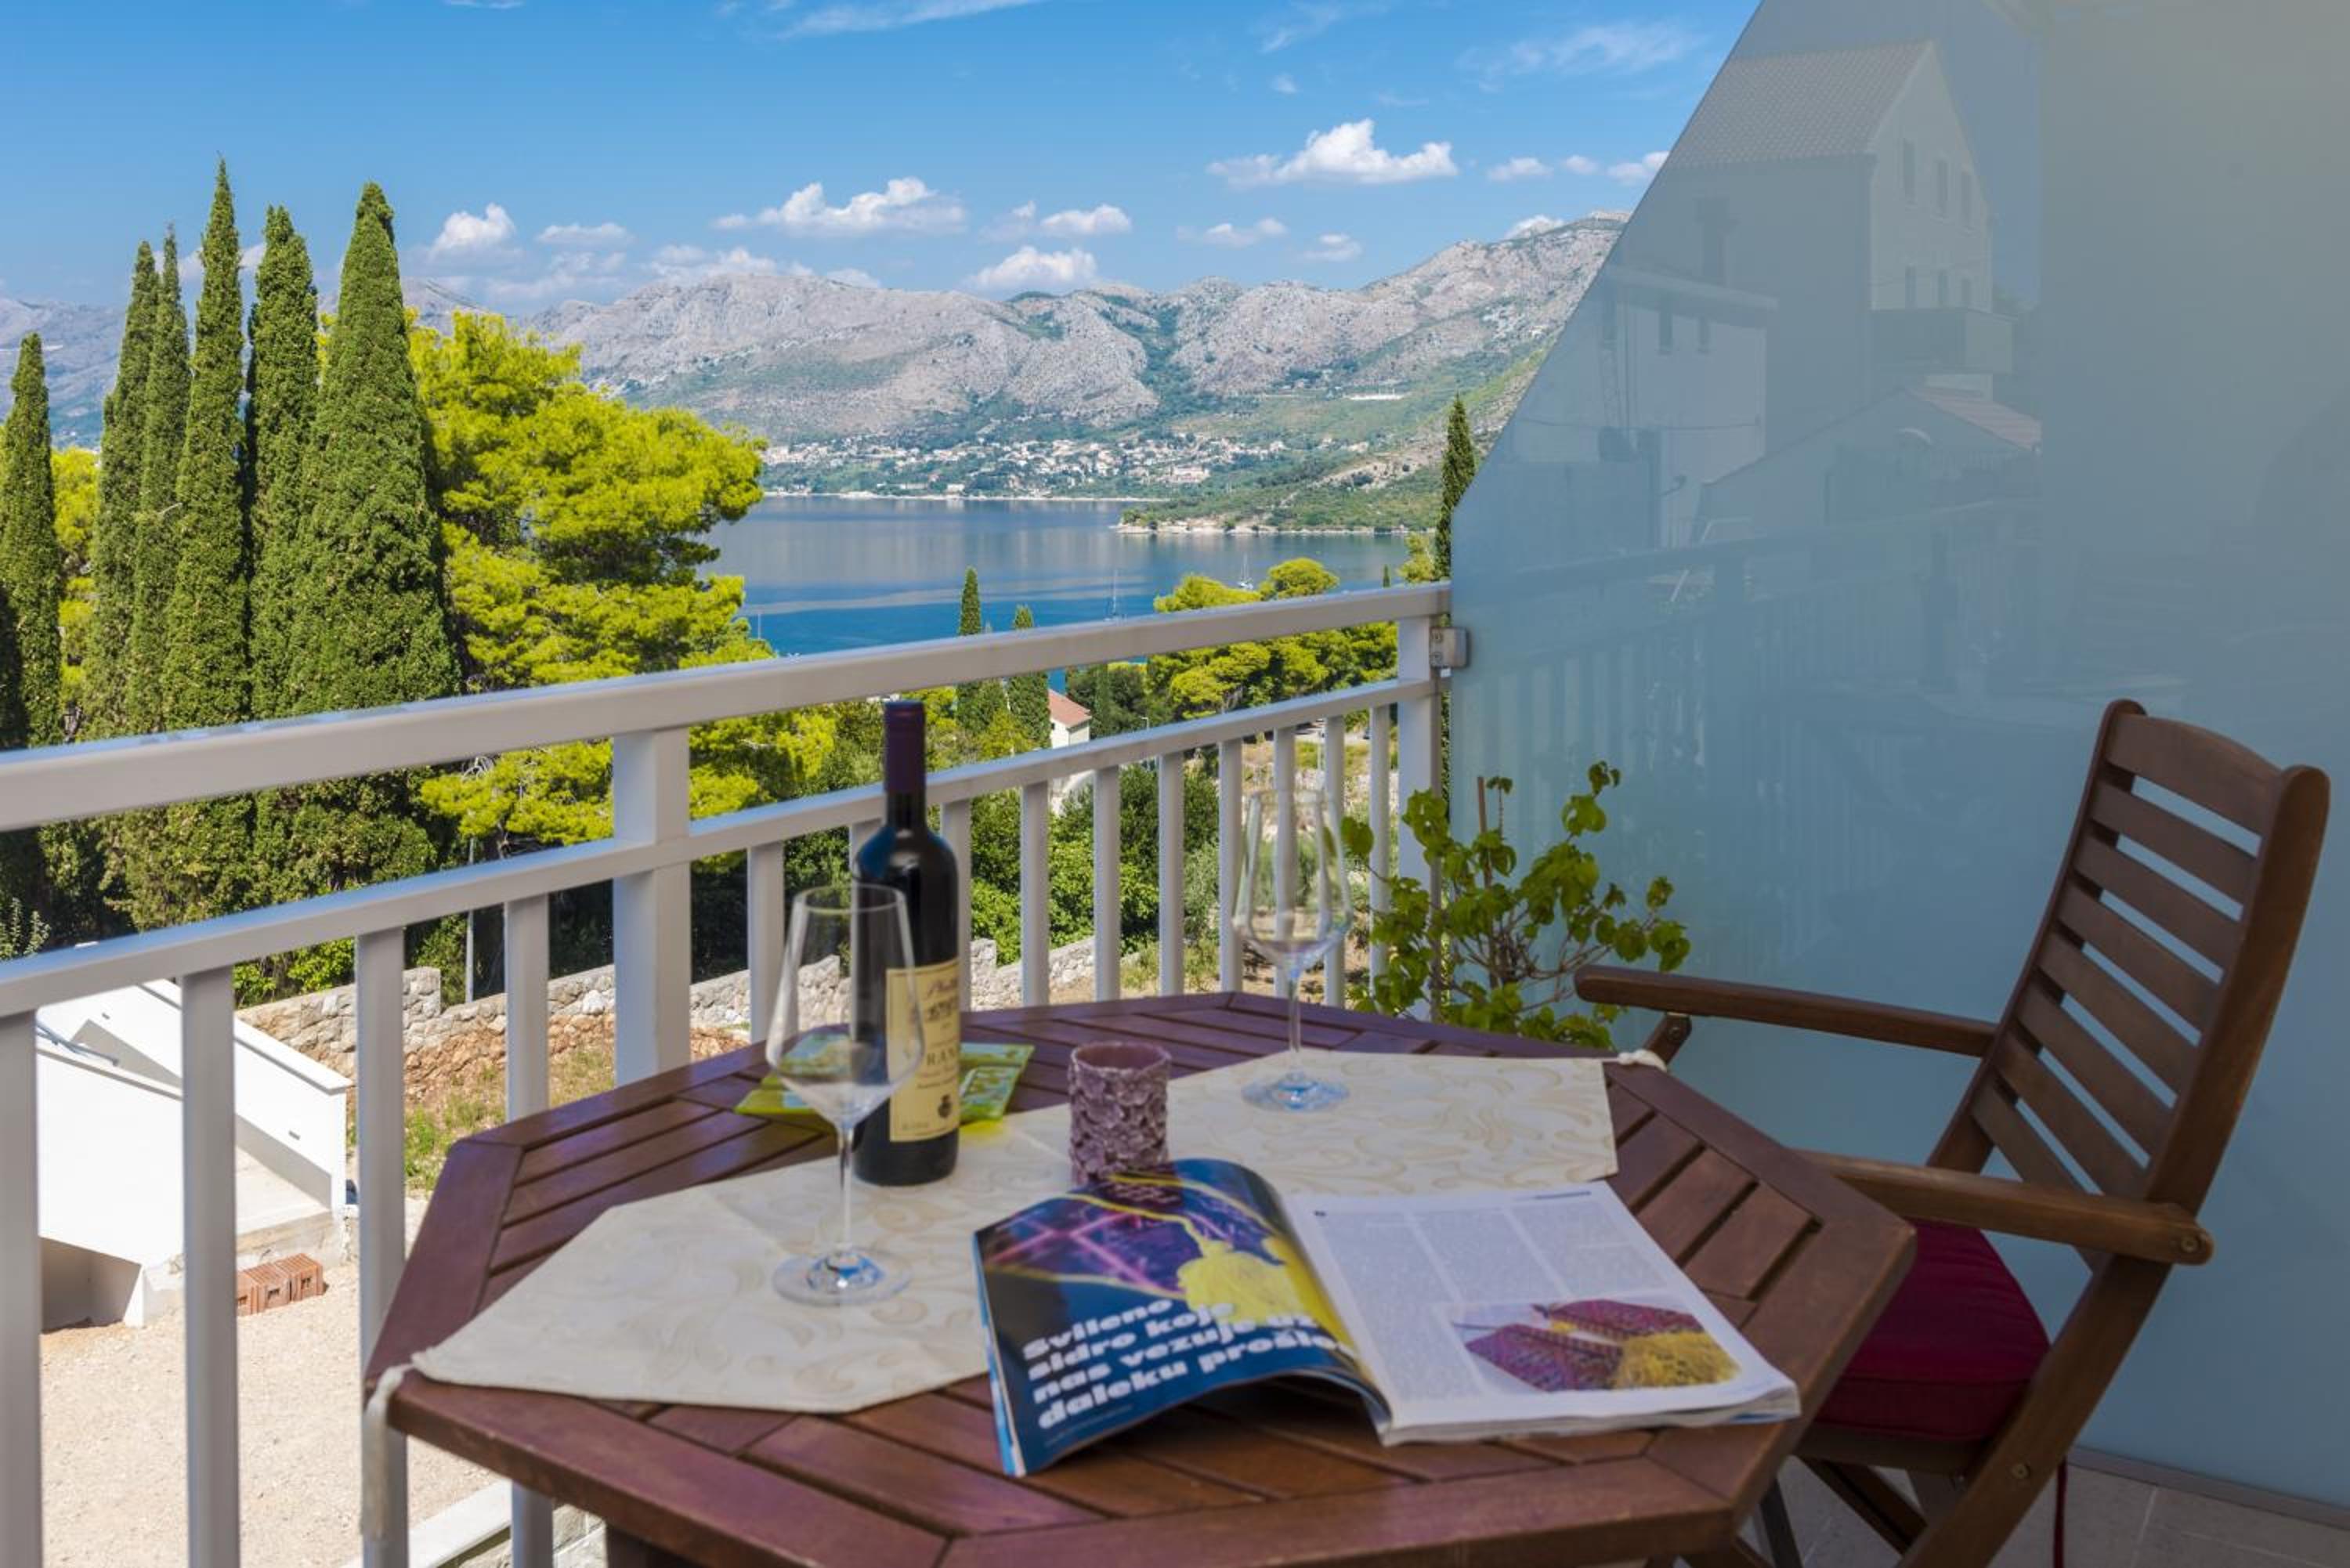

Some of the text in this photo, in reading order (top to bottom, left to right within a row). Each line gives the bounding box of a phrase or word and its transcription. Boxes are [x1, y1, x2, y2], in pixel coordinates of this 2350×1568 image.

[1023, 1299, 1172, 1360] Svileno
[1028, 1303, 1234, 1382] sidro koje
[1033, 1363, 1111, 1404] nas
[1119, 1318, 1256, 1367] vezuje
[1038, 1360, 1188, 1429] daleku
